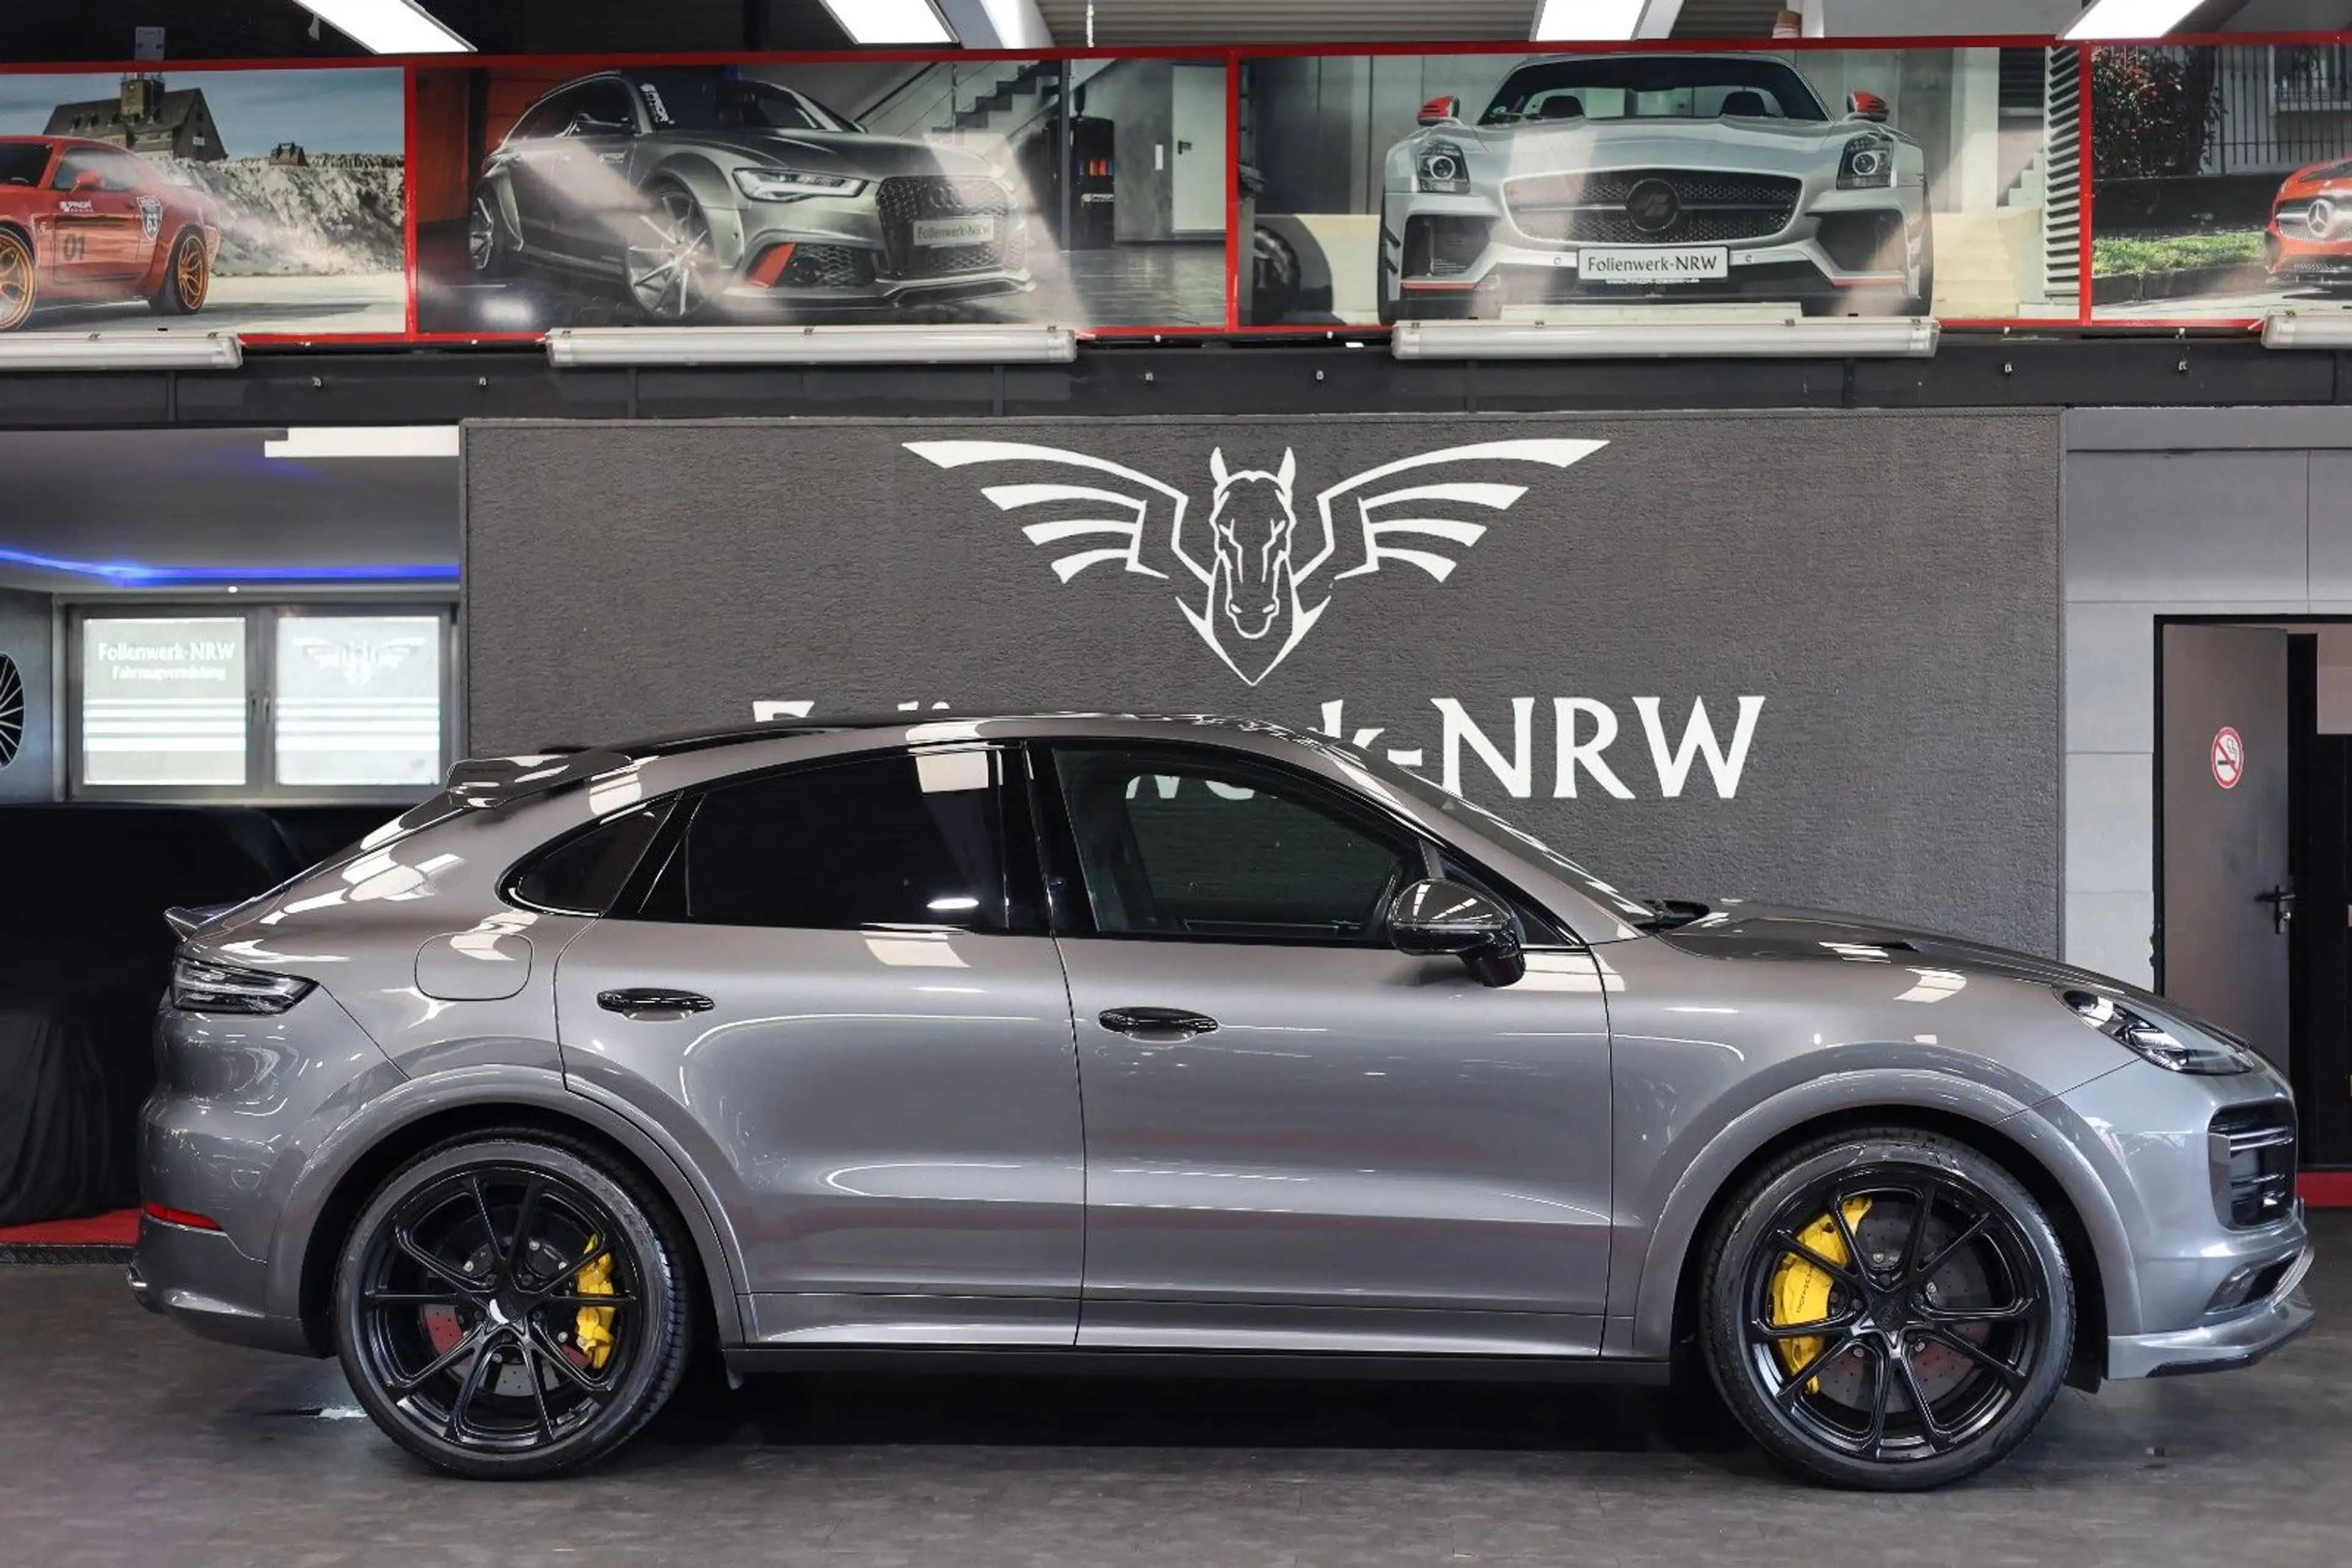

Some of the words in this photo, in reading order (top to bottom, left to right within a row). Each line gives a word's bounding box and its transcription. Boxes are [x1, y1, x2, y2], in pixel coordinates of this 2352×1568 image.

[148, 214, 158, 232] 63
[64, 233, 85, 260] 01
[1588, 255, 1717, 271] Folienwerk-NRW
